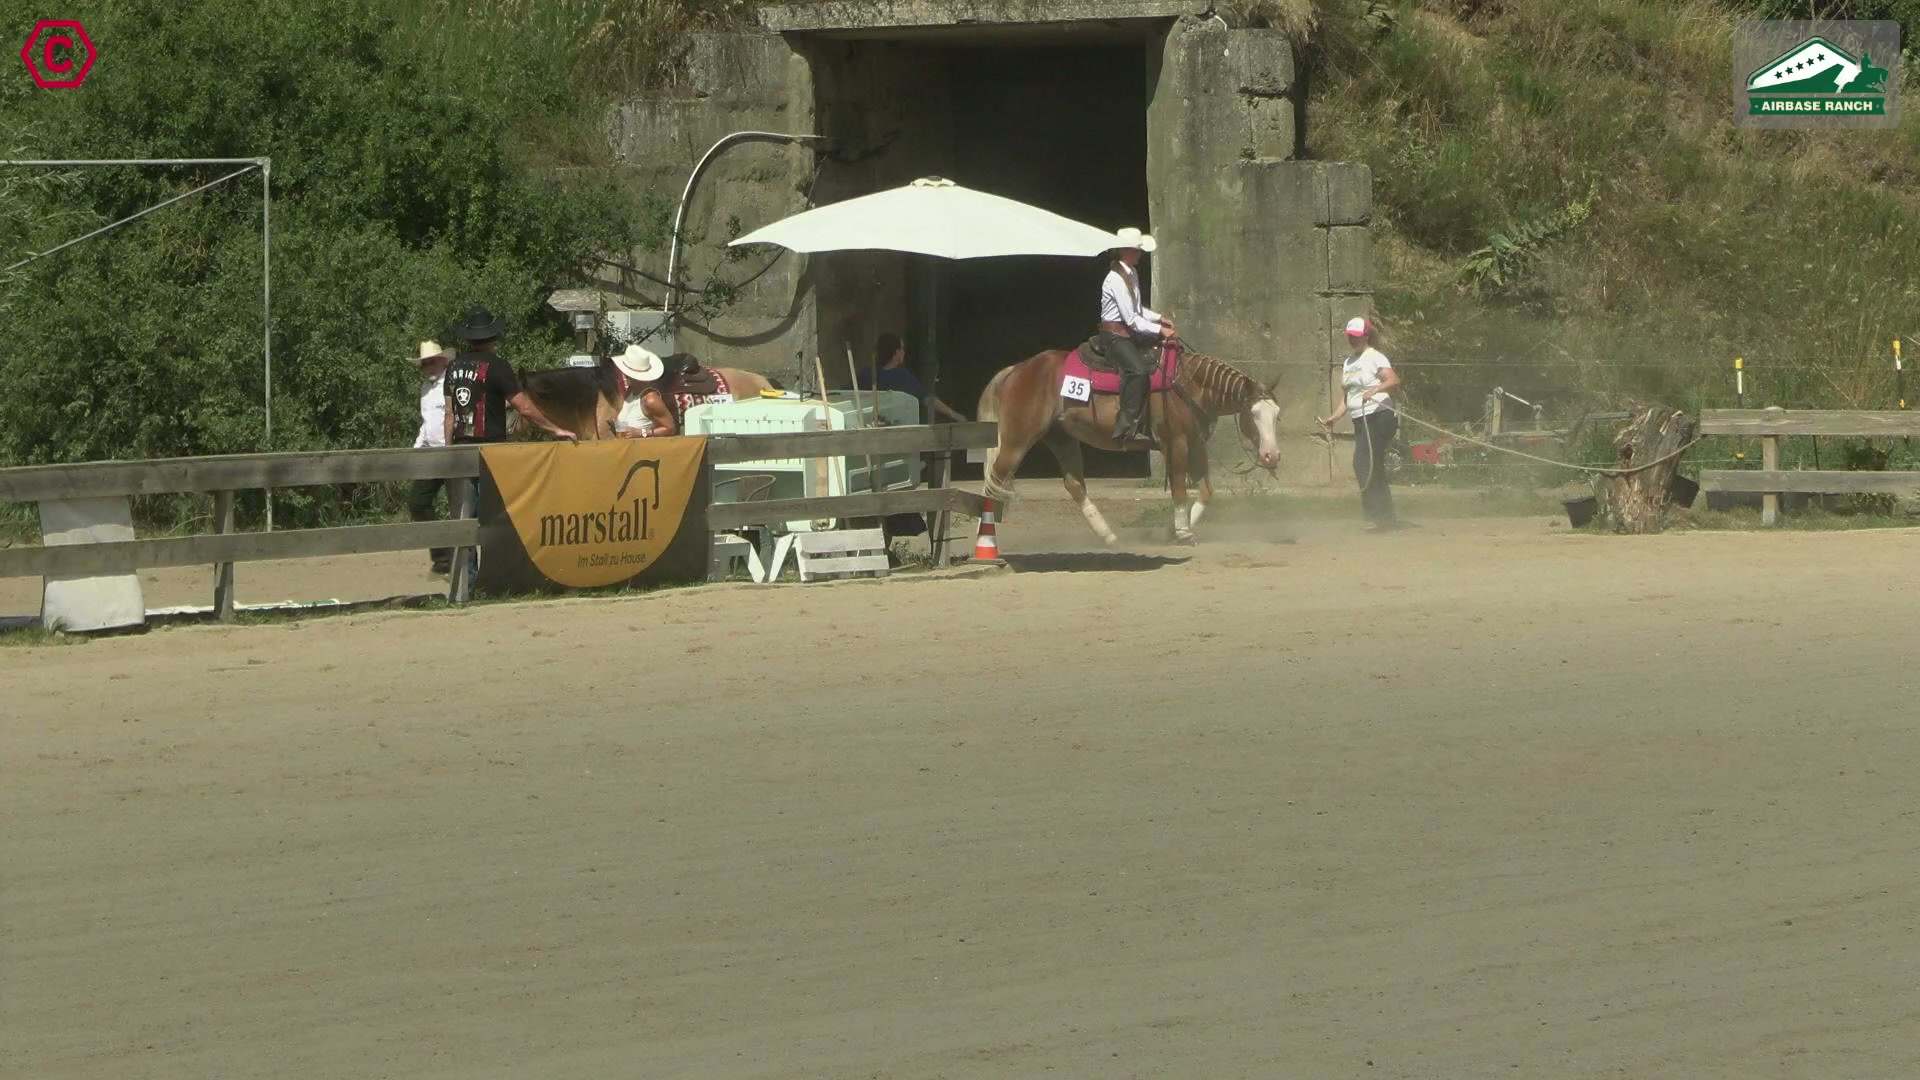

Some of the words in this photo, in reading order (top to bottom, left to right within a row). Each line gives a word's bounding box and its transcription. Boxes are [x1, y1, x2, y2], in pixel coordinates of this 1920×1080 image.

[453, 369, 478, 381] ARIAT
[1068, 381, 1084, 396] 35
[540, 498, 648, 547] marstall
[590, 553, 608, 567] Stall
[609, 555, 619, 566] zu
